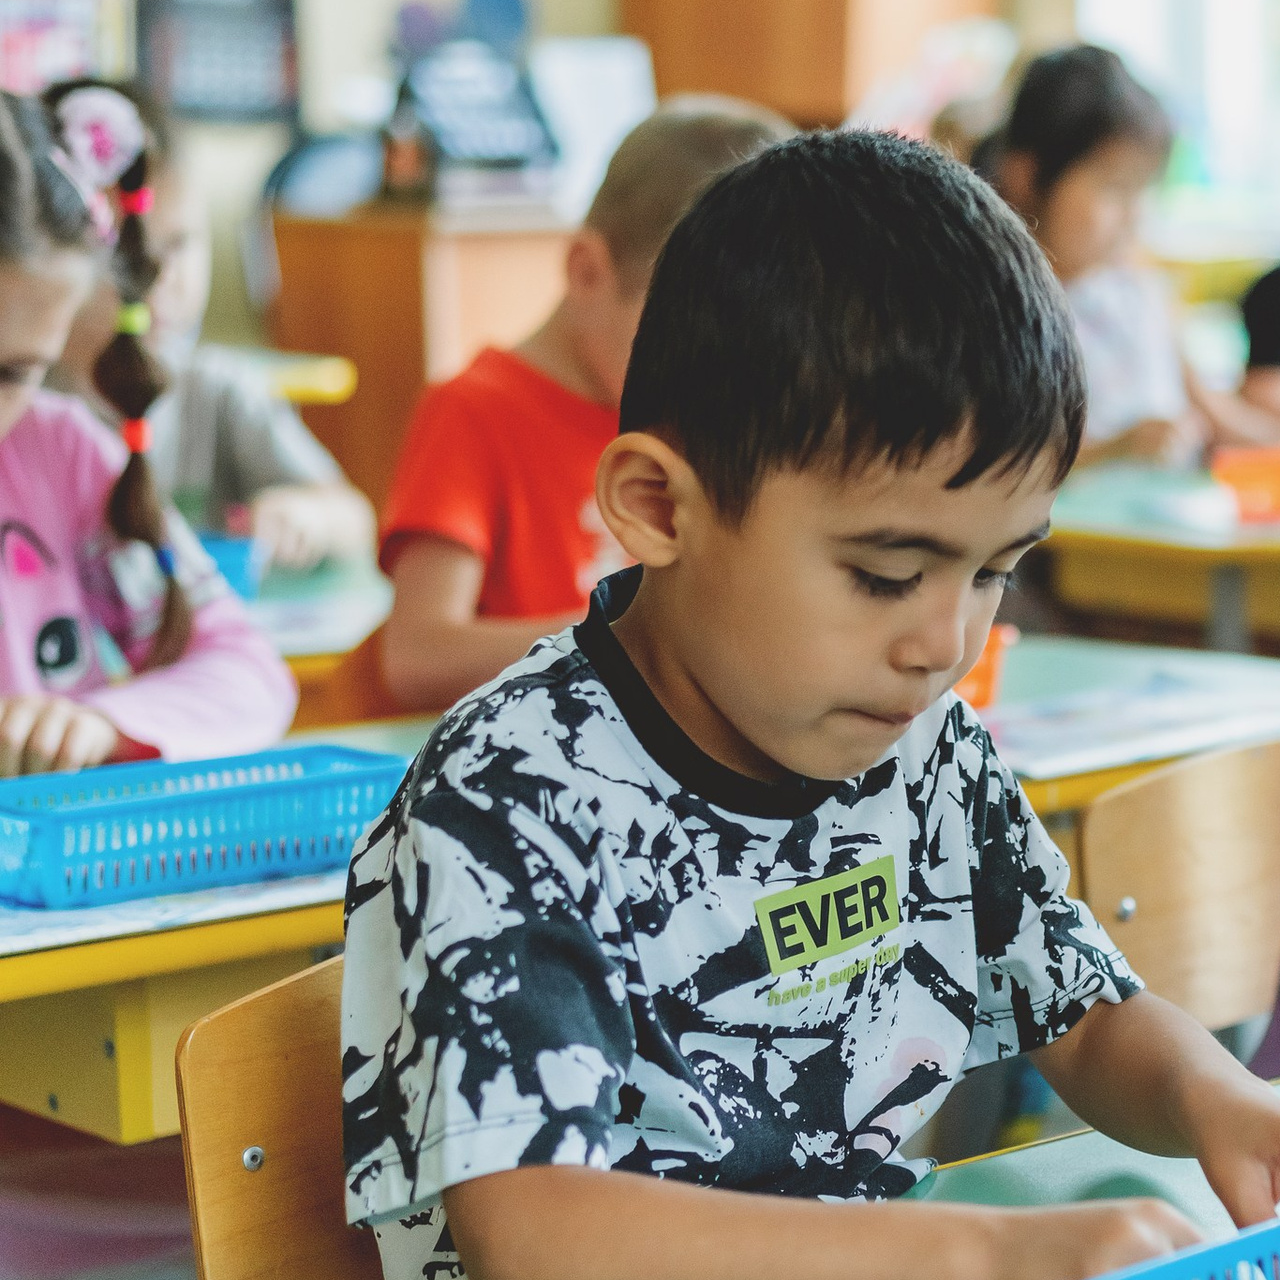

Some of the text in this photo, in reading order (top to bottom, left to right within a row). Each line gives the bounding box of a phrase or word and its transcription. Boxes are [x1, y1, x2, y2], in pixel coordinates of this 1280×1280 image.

[769, 875, 890, 961] EVER
[767, 943, 900, 1007] have a super day
